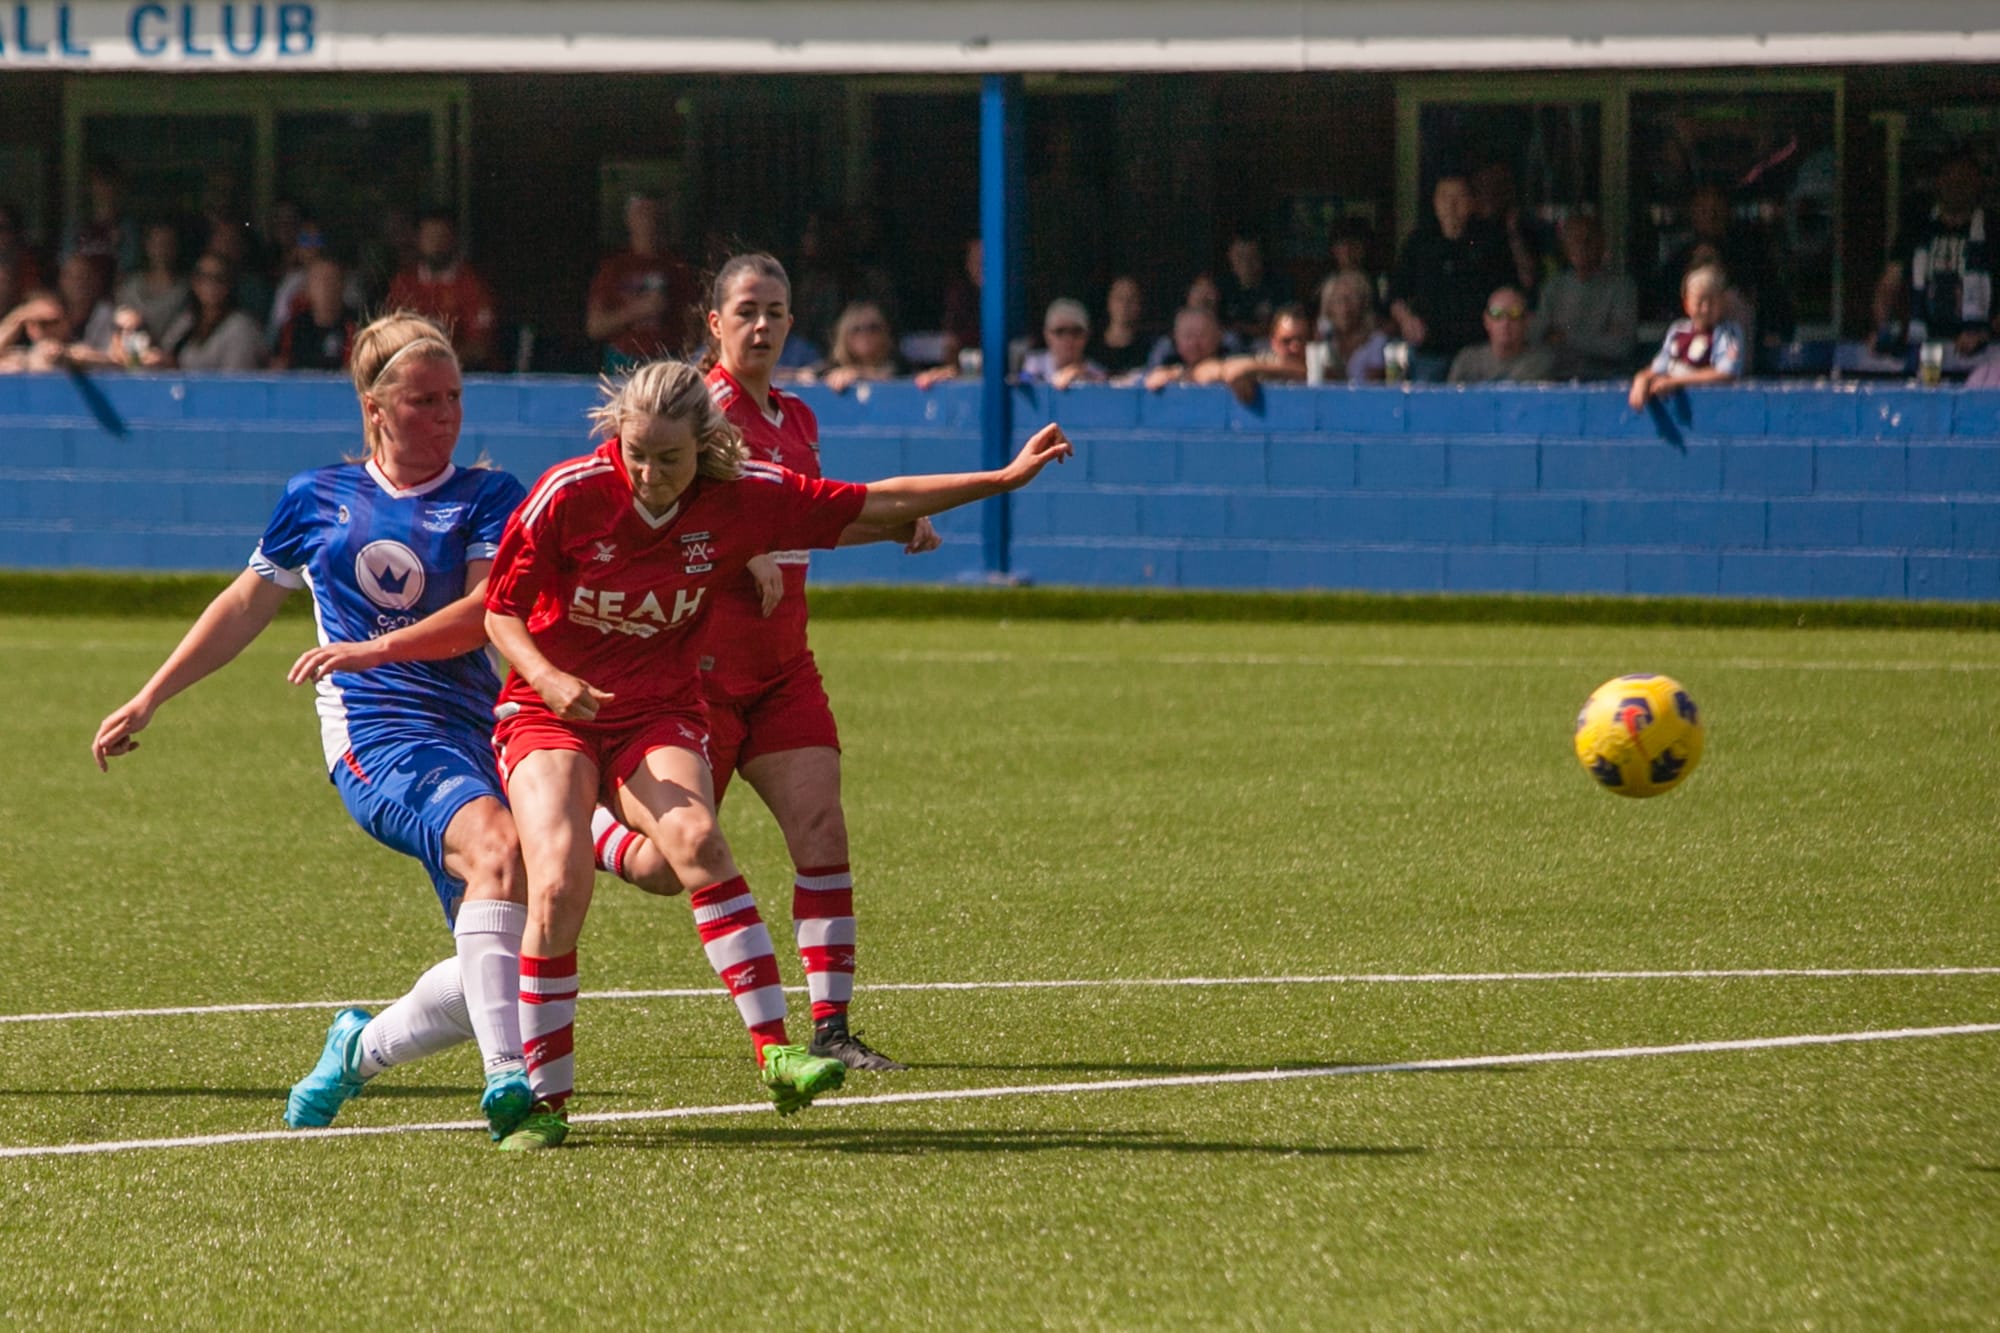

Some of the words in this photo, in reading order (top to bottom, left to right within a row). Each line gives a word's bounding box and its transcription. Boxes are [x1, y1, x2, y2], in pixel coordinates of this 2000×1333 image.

[0, 5, 90, 56] LL
[127, 4, 315, 56] CLUB
[569, 586, 706, 623] SEAH
